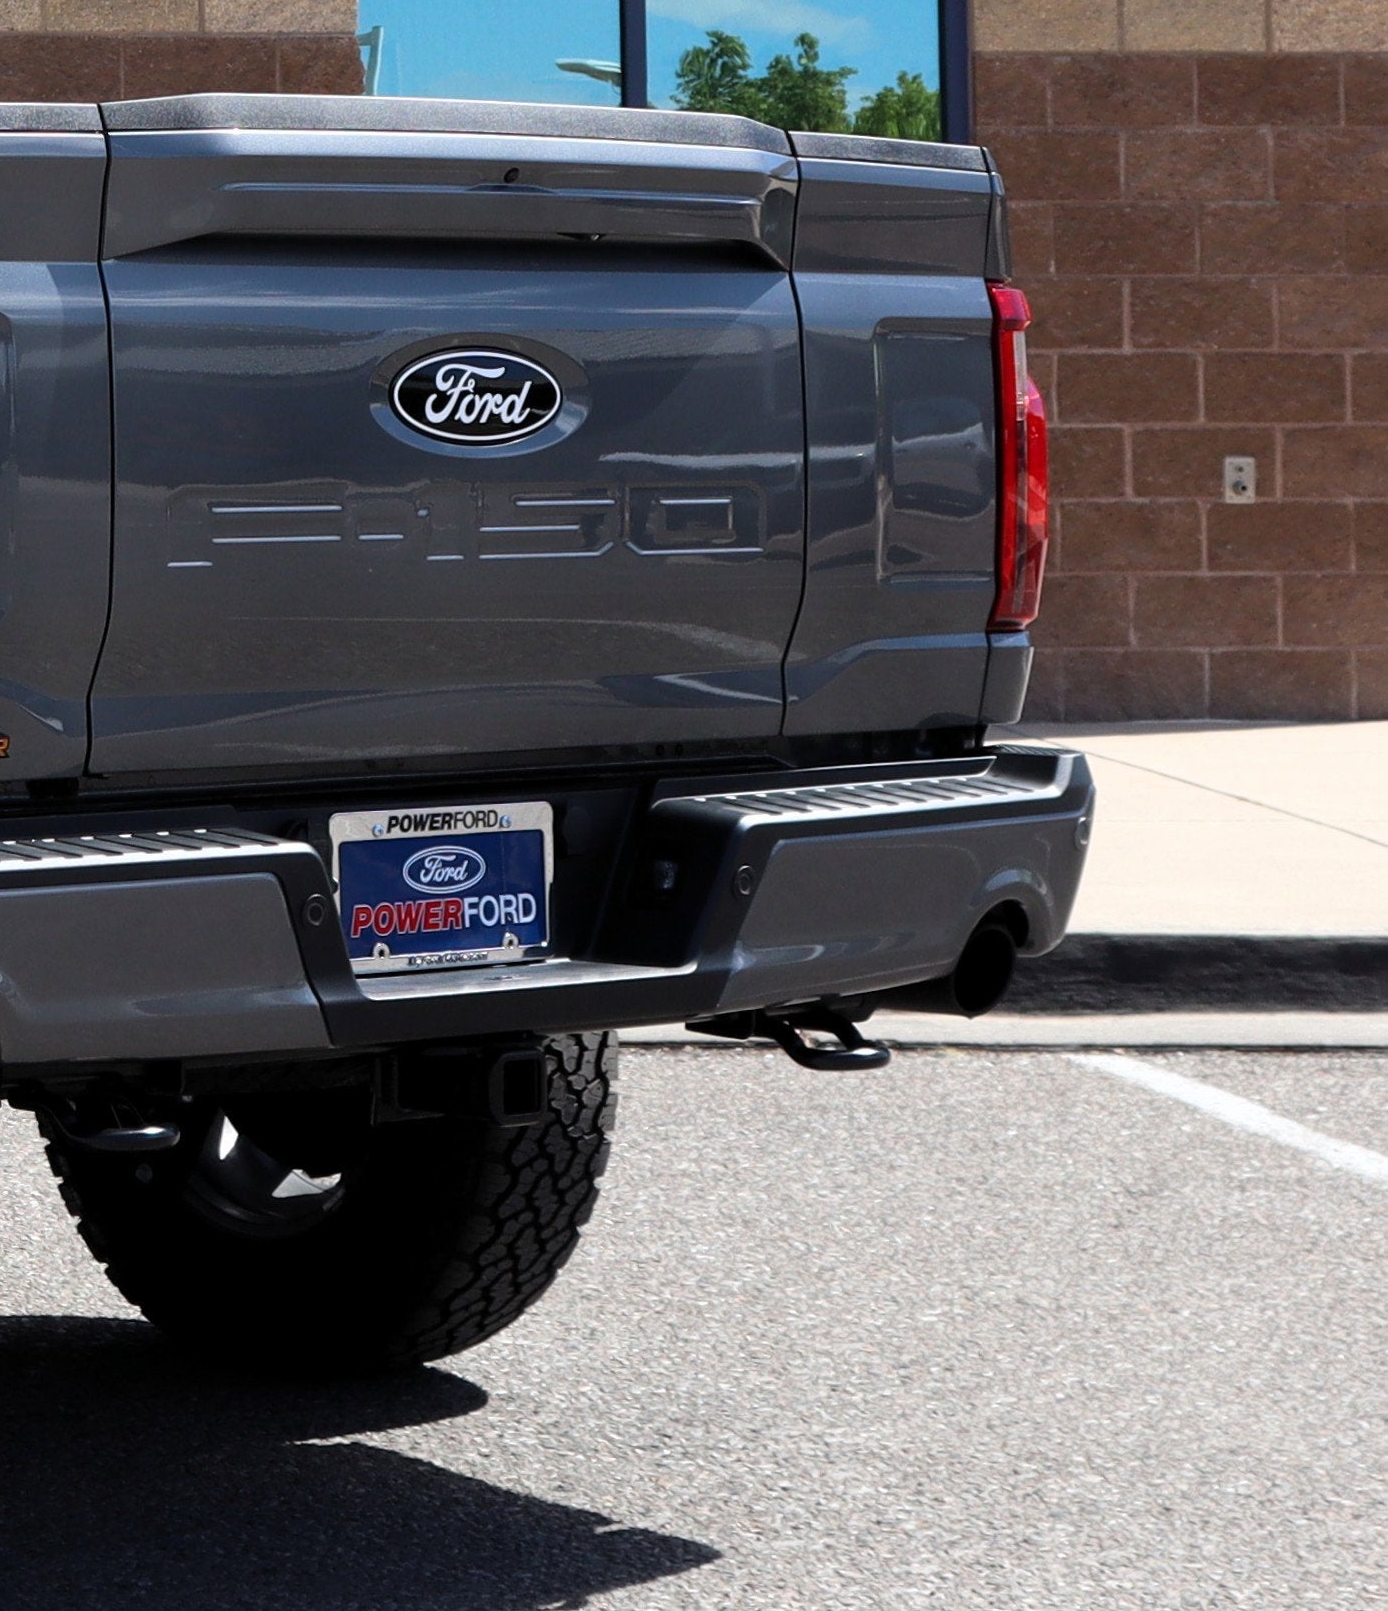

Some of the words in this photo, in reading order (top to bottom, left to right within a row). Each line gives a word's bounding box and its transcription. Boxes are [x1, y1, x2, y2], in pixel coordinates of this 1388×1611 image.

[422, 361, 533, 428] Ford
[166, 480, 766, 566] F-150
[419, 855, 469, 883] Ford
